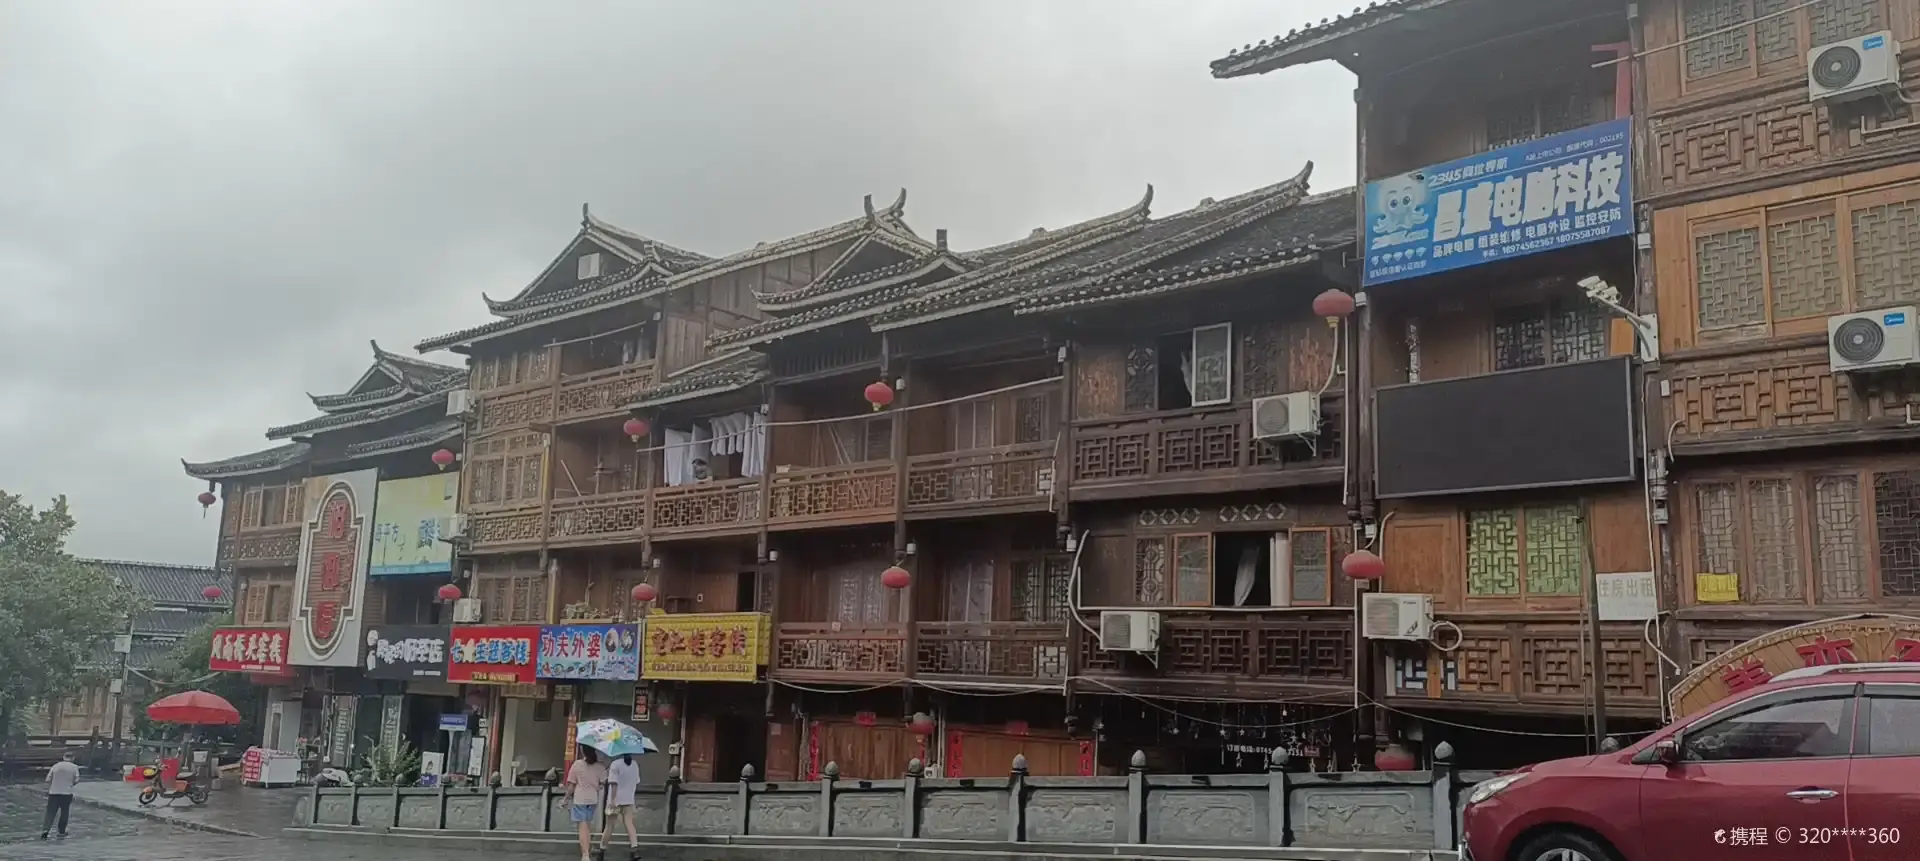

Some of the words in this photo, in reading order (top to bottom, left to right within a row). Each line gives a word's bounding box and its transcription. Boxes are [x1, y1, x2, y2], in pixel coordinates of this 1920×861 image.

[1433, 152, 1624, 241] 昌盛电脑科技
[1433, 238, 1474, 258] 品牌电脑
[1478, 229, 1521, 248] 组装维修
[1525, 218, 1570, 238] 电脑外设
[1575, 207, 1621, 228] 监控安防
[1598, 577, 1655, 598] 住房出租
[542, 631, 601, 658] 功夫外婆
